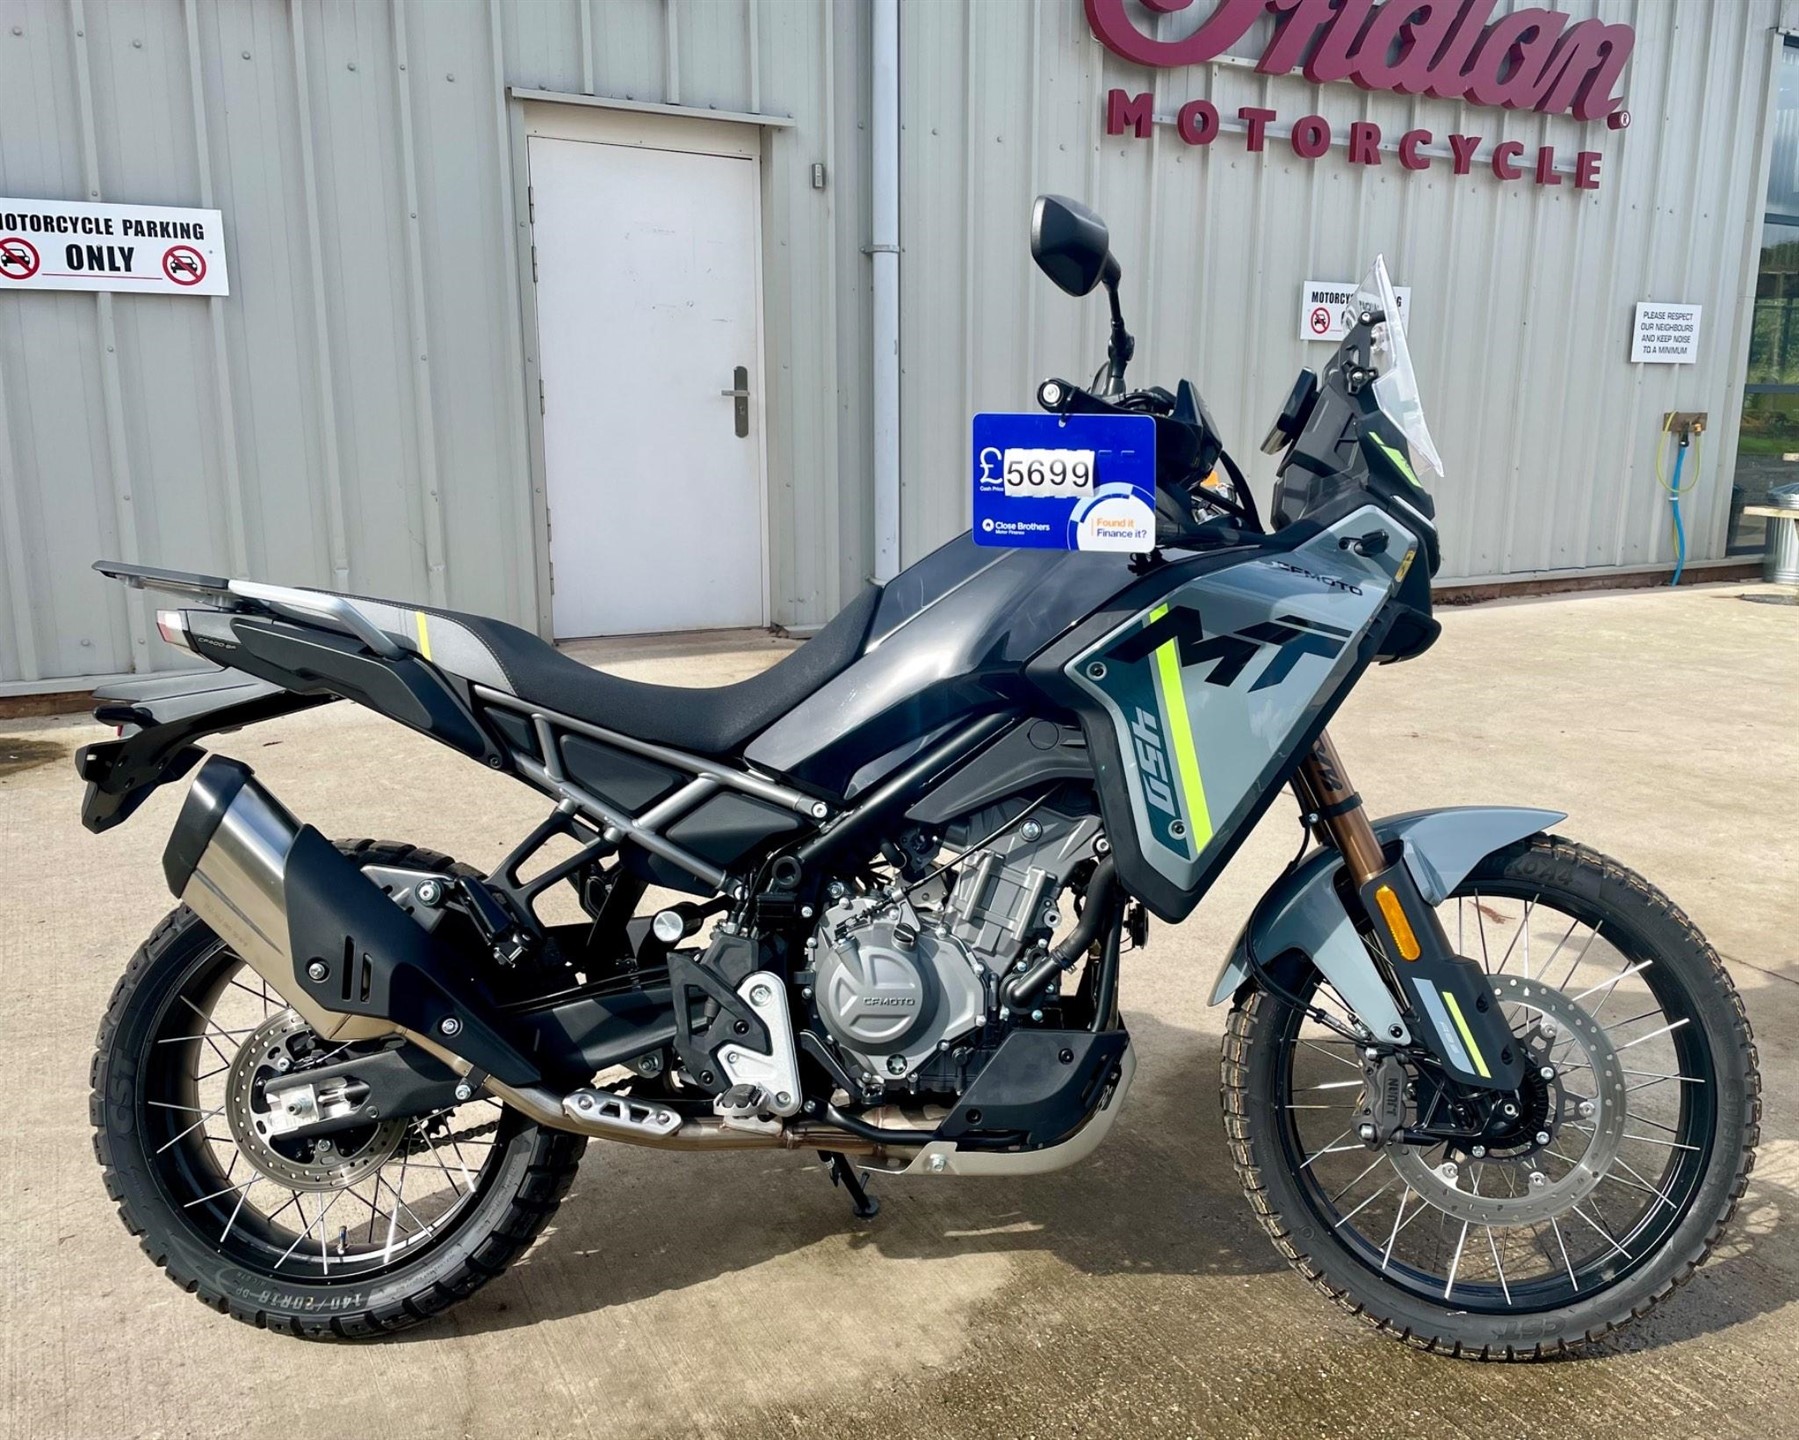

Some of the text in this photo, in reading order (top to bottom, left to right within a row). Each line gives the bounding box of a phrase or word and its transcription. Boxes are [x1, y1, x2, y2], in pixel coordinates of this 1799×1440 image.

[1107, 88, 1602, 190] MOTORCYCLE
[0, 213, 205, 241] OTORCYCLE PARKING
[66, 243, 135, 273] ONLY
[1311, 291, 1354, 305] MOTORCY
[1643, 311, 1693, 321] PLEASE RESPECT
[1640, 322, 1694, 333] OUR NEIGHBOURS
[1641, 334, 1691, 344] AND KEEP NOISE
[1643, 345, 1687, 354] TO A MINIMUM
[995, 521, 1050, 531] Close Brothers
[1096, 517, 1134, 528] Found it
[1096, 528, 1147, 539] Finance it?
[1131, 706, 1178, 817] 450
[863, 996, 915, 1007] CFMOTO
